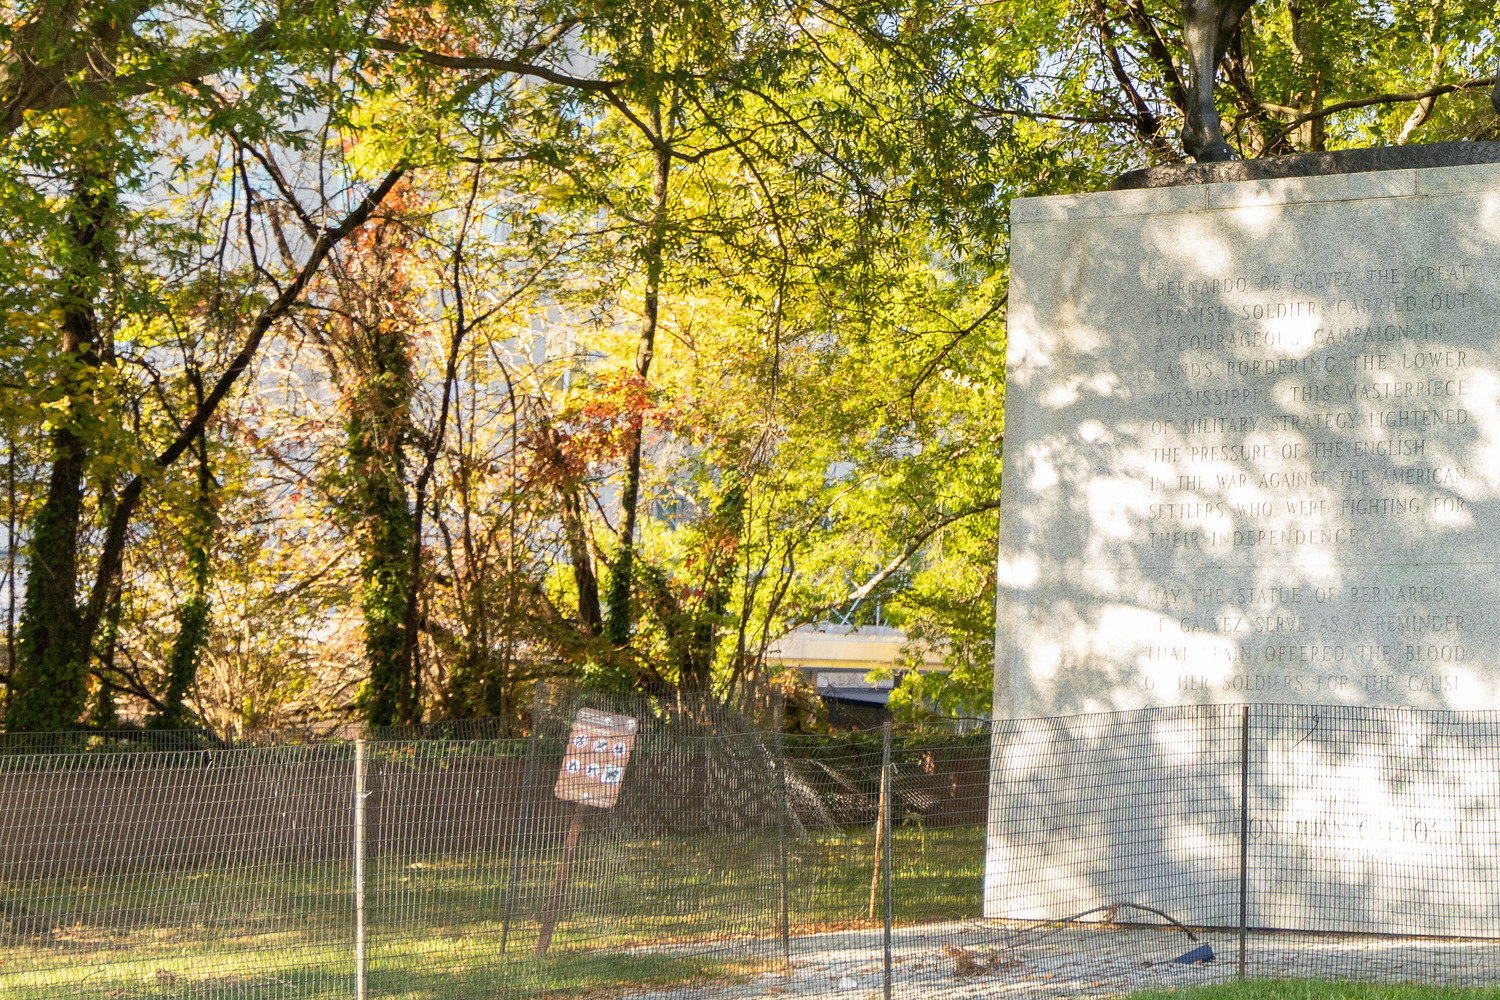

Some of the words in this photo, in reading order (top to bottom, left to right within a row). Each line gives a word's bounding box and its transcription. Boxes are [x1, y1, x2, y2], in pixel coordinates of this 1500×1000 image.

[1156, 277, 1246, 297] BERNARDO
[1260, 275, 1282, 290] DE
[1293, 271, 1352, 289] GALVEZ
[1367, 269, 1399, 286] THE
[1414, 264, 1470, 283] GREAT
[1155, 306, 1228, 325] SPANISH
[1337, 297, 1416, 315] CARRIED
[1431, 294, 1471, 310] OUT
[1155, 336, 1165, 352] A
[1314, 325, 1408, 345] CAMPAIGN
[1423, 324, 1443, 338] IN
[1154, 362, 1213, 380] LANDS
[1227, 357, 1335, 377] BORDERING
[1351, 355, 1386, 370] THE
[1403, 351, 1467, 369] LOWER
[1289, 385, 1331, 401] THIS
[1348, 380, 1467, 399] MASTERPIECE
[1151, 420, 1170, 435] OF
[1184, 417, 1259, 434] MILITARY
[1271, 412, 1357, 432] STRATEGY
[1371, 409, 1467, 428] LIGHTENED
[1151, 447, 1182, 463] THE
[1191, 443, 1271, 462] PRESSURE
[1282, 443, 1302, 459] OF
[1312, 442, 1344, 457] THE
[1354, 439, 1425, 457] ENGLISH
[1151, 475, 1167, 492] IN
[1176, 475, 1205, 490] THE
[1216, 474, 1246, 489] WAR
[1258, 471, 1328, 489] AGAINST
[1340, 470, 1373, 486] THE
[1381, 467, 1466, 485] AMERICAN
[1237, 502, 1273, 518] WHO
[1286, 500, 1326, 516] WERE
[1342, 498, 1419, 516] FIGHTING
[1433, 497, 1465, 513] FOR
[1149, 532, 1199, 549] THEIR
[1147, 589, 1181, 604] MAY
[1191, 588, 1223, 603] THE
[1237, 587, 1301, 603] STATUE
[1314, 587, 1336, 603] OF
[1351, 586, 1444, 603] BERNARDO
[1150, 618, 1164, 633] E
[1255, 616, 1306, 633] SERVE
[1319, 616, 1339, 633] AS
[1352, 617, 1362, 633] A
[1376, 615, 1465, 633] REMINDER
[1202, 647, 1250, 662] PAIN
[1265, 645, 1344, 662] OFFERED
[1358, 647, 1390, 662] THE
[1406, 645, 1465, 662] BLOOD
[1144, 676, 1161, 691] O
[1222, 675, 1303, 692] SOLDIERS
[1317, 676, 1348, 691] FOR
[1361, 675, 1394, 691] THE
